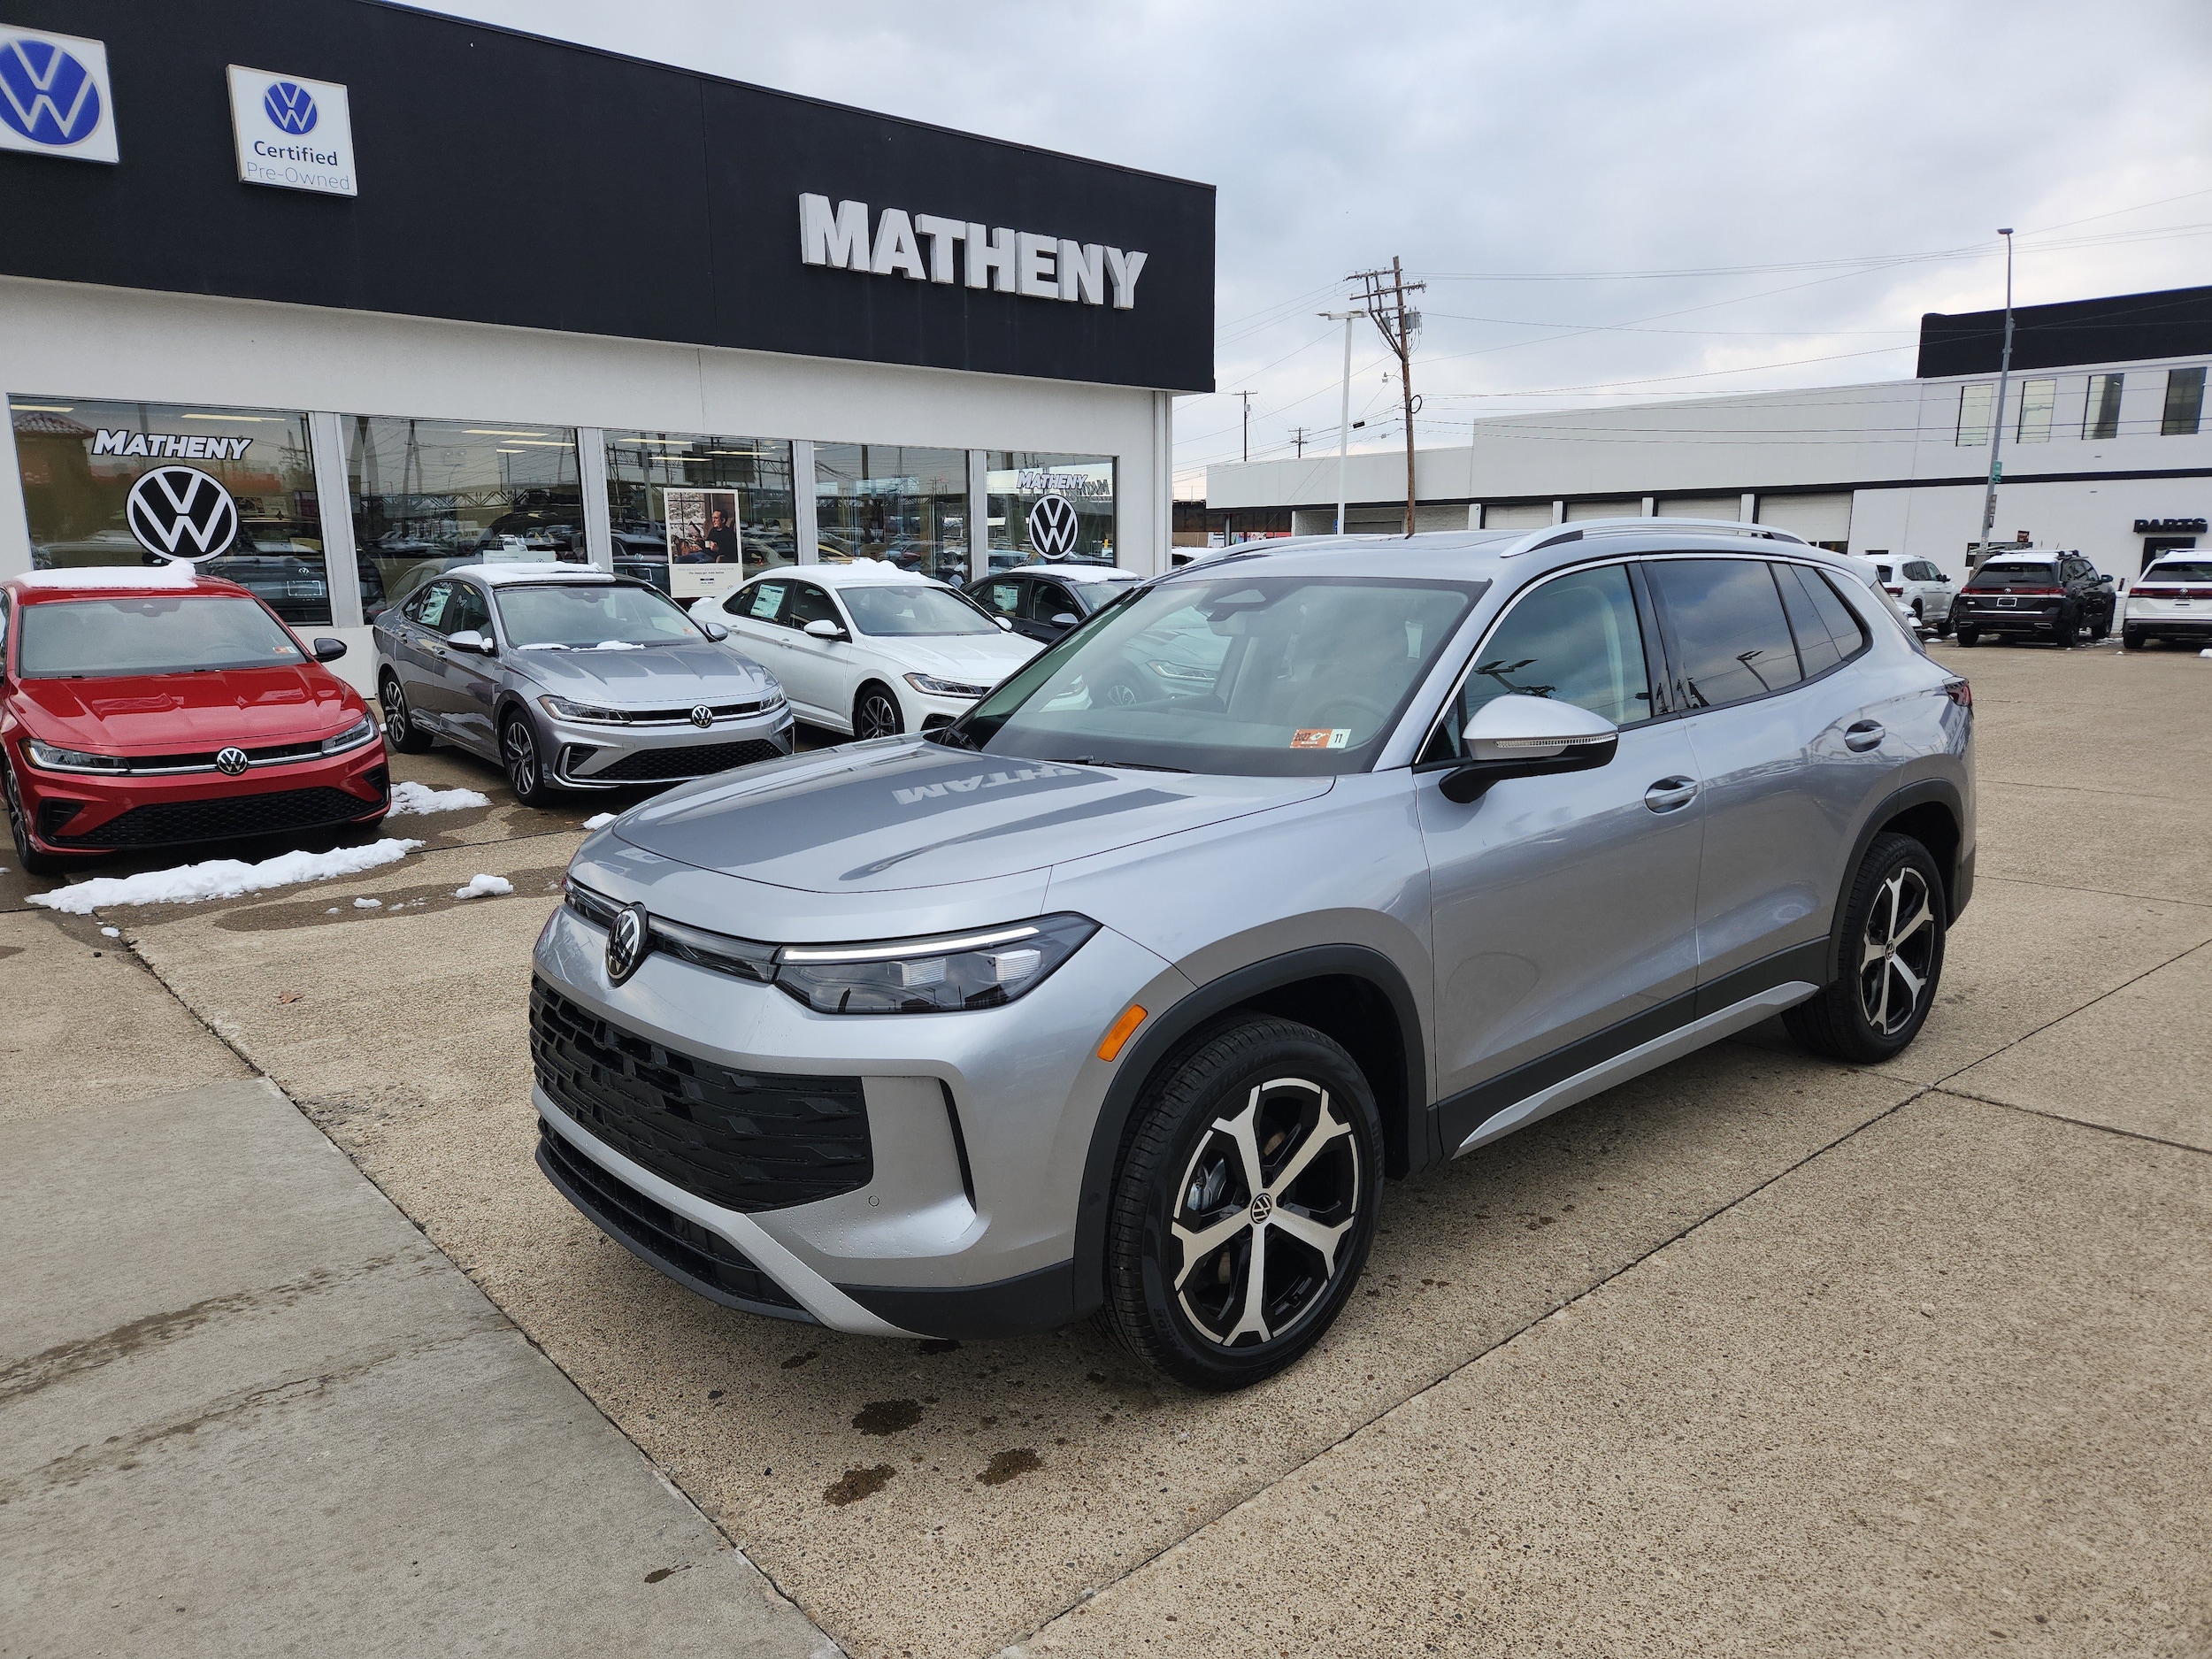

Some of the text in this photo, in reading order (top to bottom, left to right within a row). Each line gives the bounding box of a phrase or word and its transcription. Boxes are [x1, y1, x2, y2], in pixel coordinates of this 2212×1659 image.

[253, 140, 338, 166] Certified
[247, 161, 350, 190] Pre-Owned
[798, 192, 1148, 310] MATHENY
[92, 428, 254, 460] MATHENY
[1017, 471, 1088, 490] MATHENY
[2133, 518, 2208, 534] PARTS
[1294, 733, 1311, 741] 2027
[1334, 733, 1344, 743] 11
